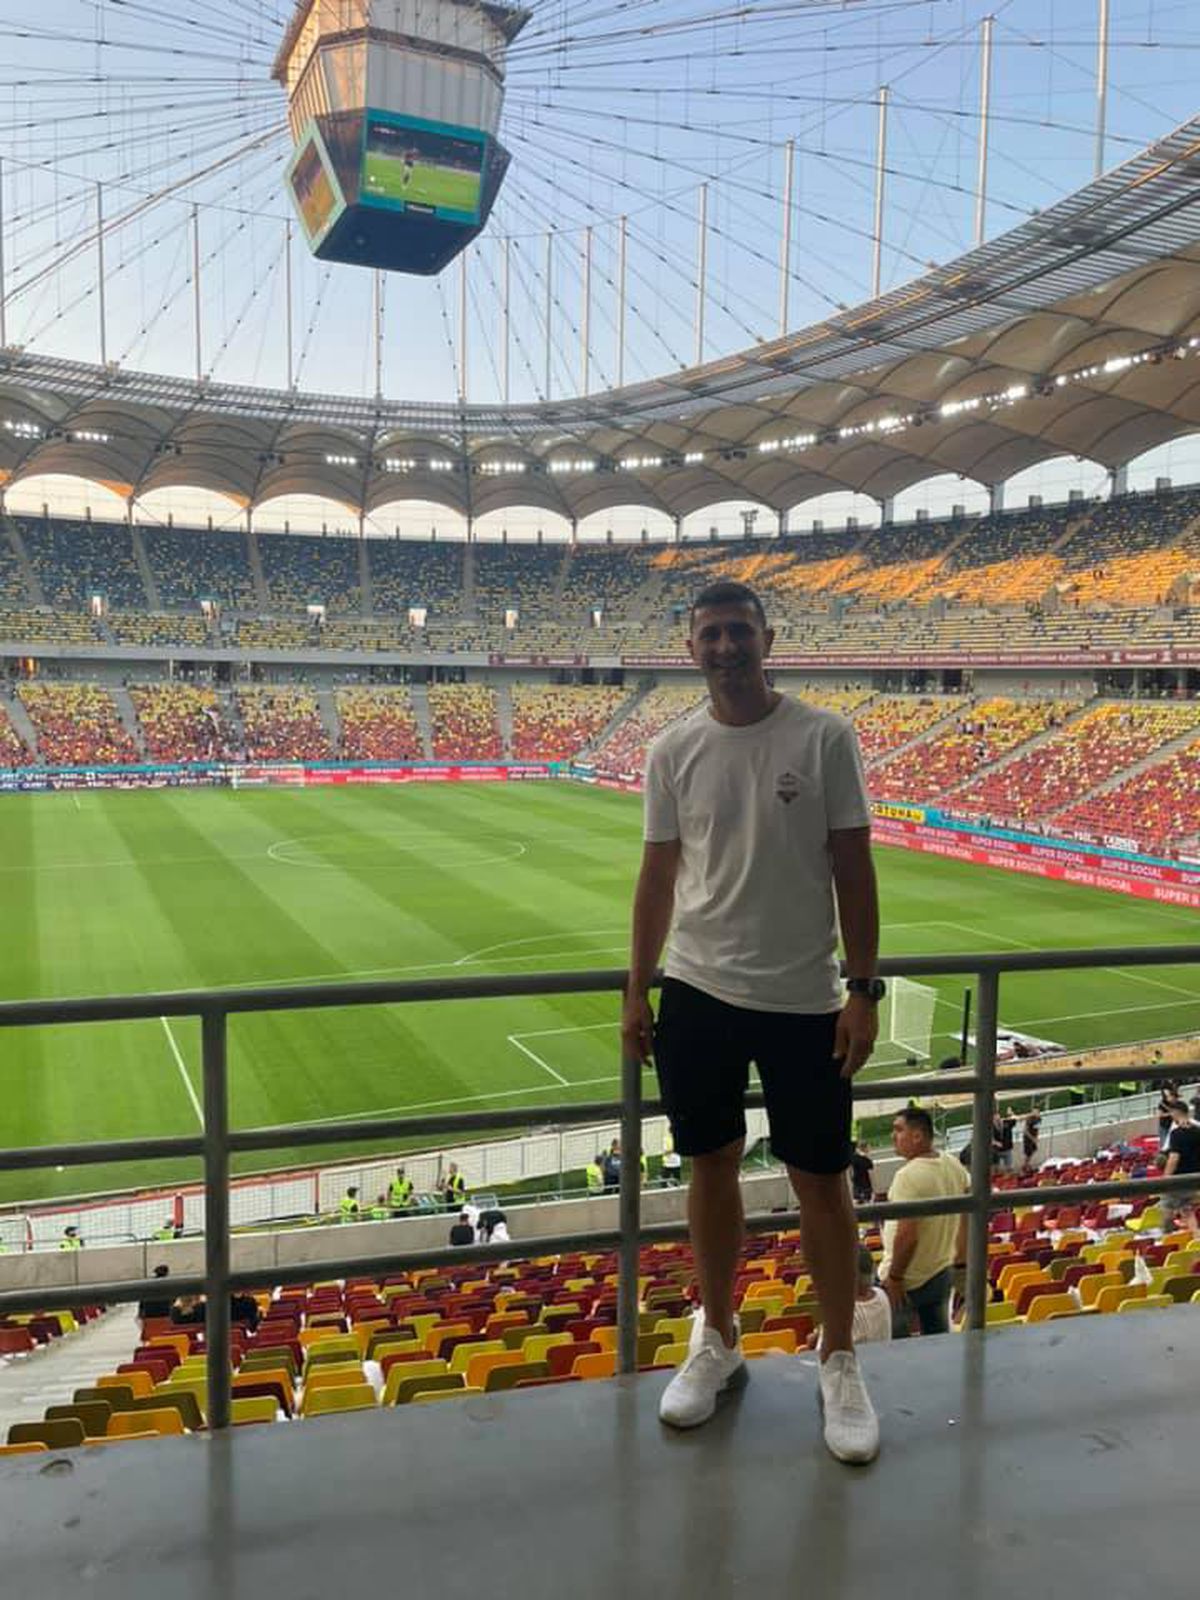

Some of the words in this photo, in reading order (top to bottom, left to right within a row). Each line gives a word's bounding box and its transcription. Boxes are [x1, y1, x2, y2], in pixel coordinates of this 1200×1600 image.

[1131, 863, 1162, 878] SOCIAL
[1065, 869, 1094, 885] SUPER
[1096, 875, 1132, 892] SOCIAL
[1153, 887, 1189, 904] SUPER
